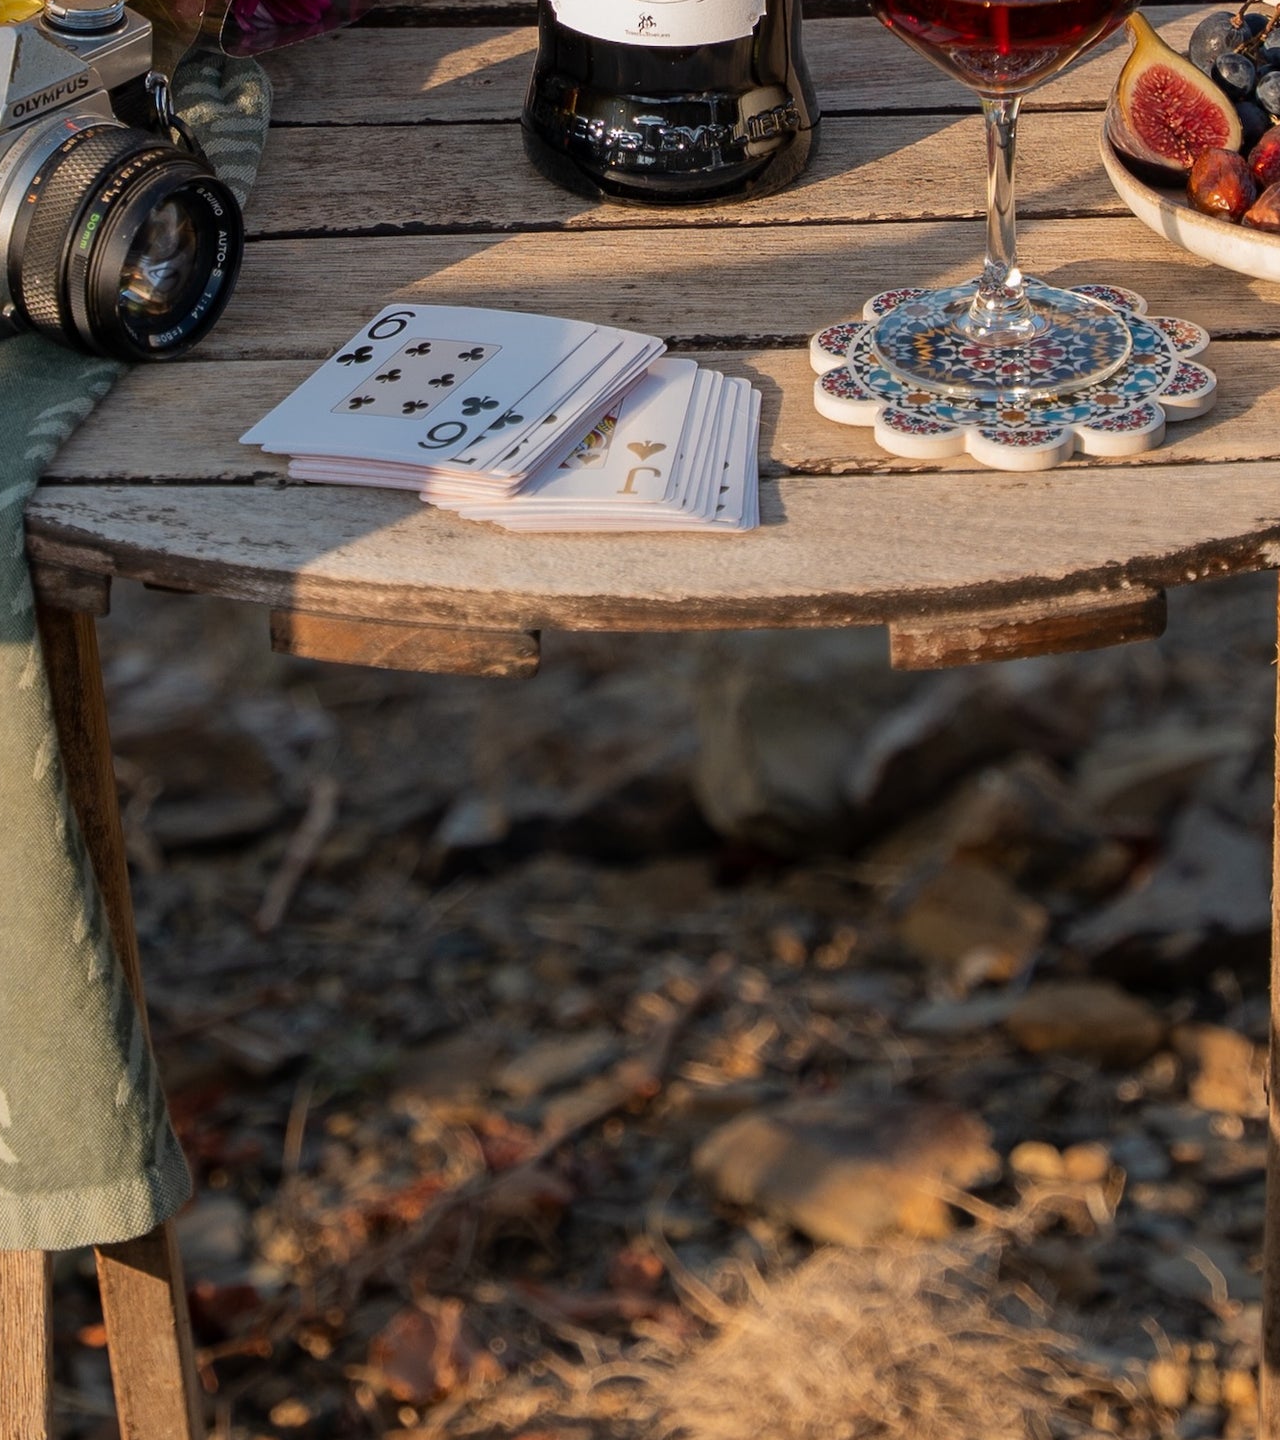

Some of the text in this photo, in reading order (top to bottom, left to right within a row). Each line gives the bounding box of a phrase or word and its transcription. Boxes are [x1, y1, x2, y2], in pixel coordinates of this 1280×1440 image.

[13, 74, 89, 118] OLYMPUS
[80, 213, 100, 250] 50mm
[212, 230, 228, 278] AUTO-S
[368, 311, 417, 340] 6
[617, 466, 662, 495] J
